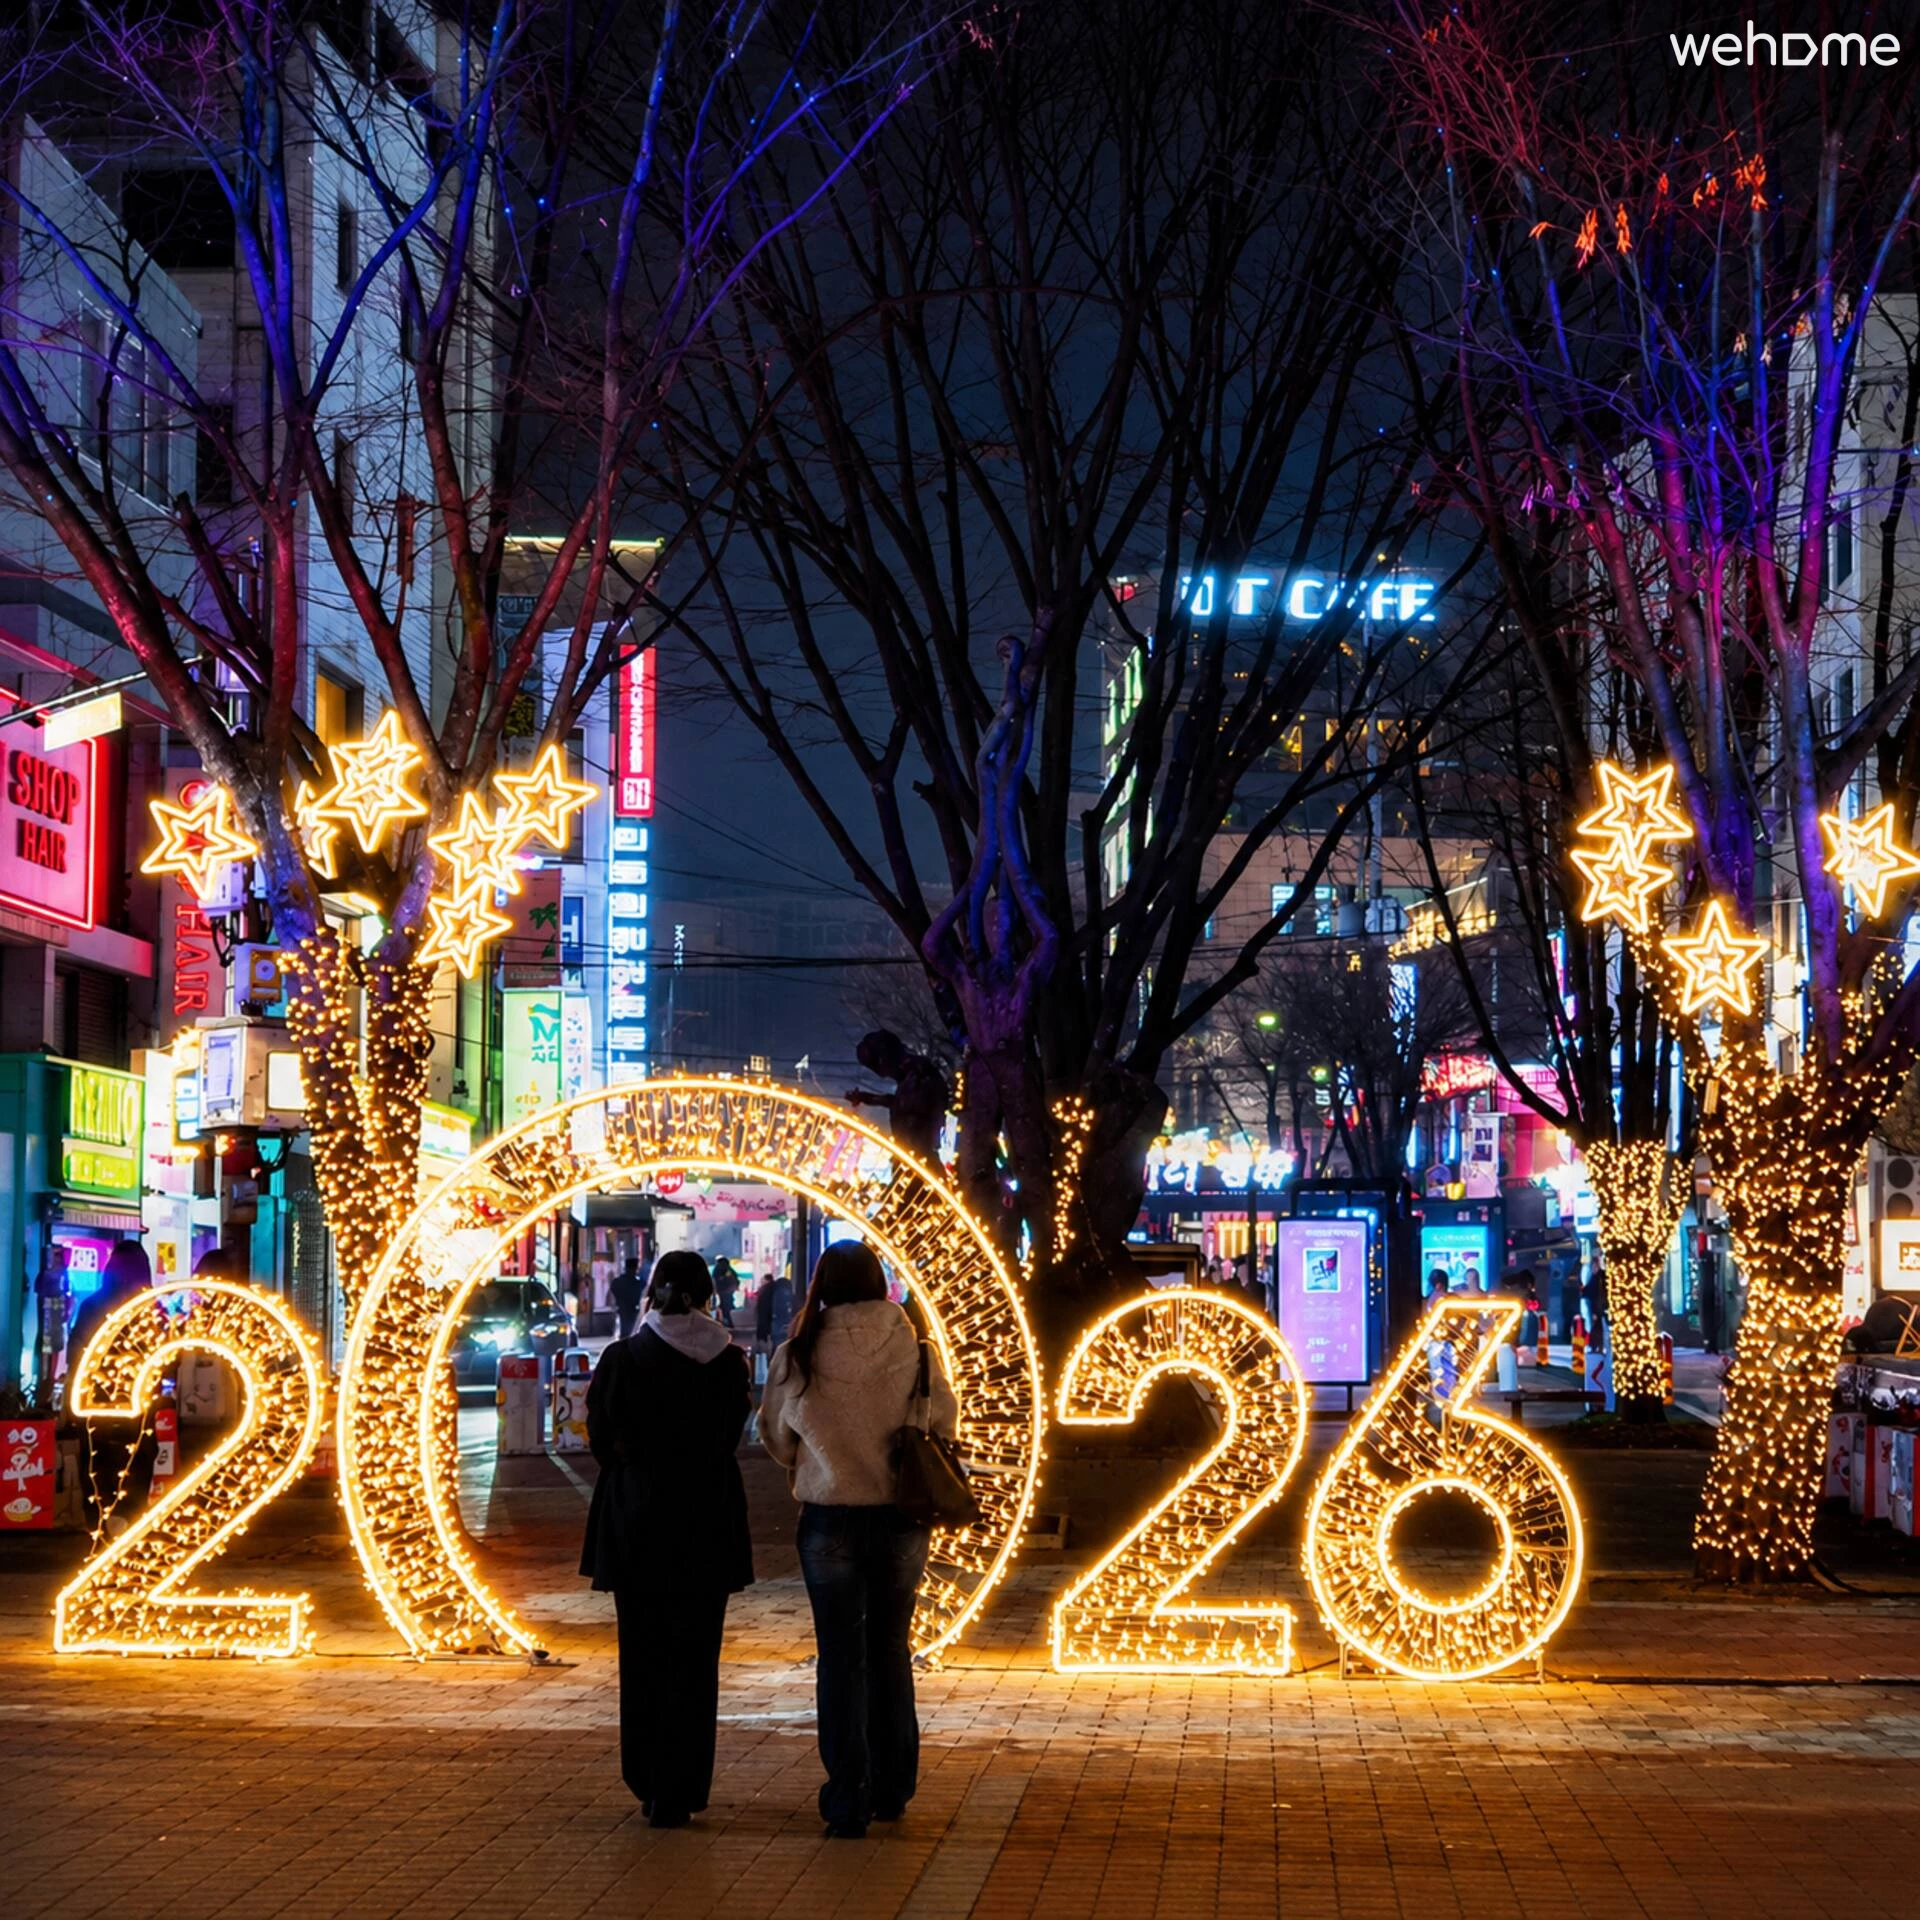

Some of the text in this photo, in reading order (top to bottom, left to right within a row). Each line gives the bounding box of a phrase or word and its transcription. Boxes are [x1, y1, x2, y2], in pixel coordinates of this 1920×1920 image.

[14, 750, 81, 826] SHOP
[21, 819, 67, 874] HAIR
[174, 904, 213, 1017] HAIR
[52, 1075, 1586, 1681] 2026
